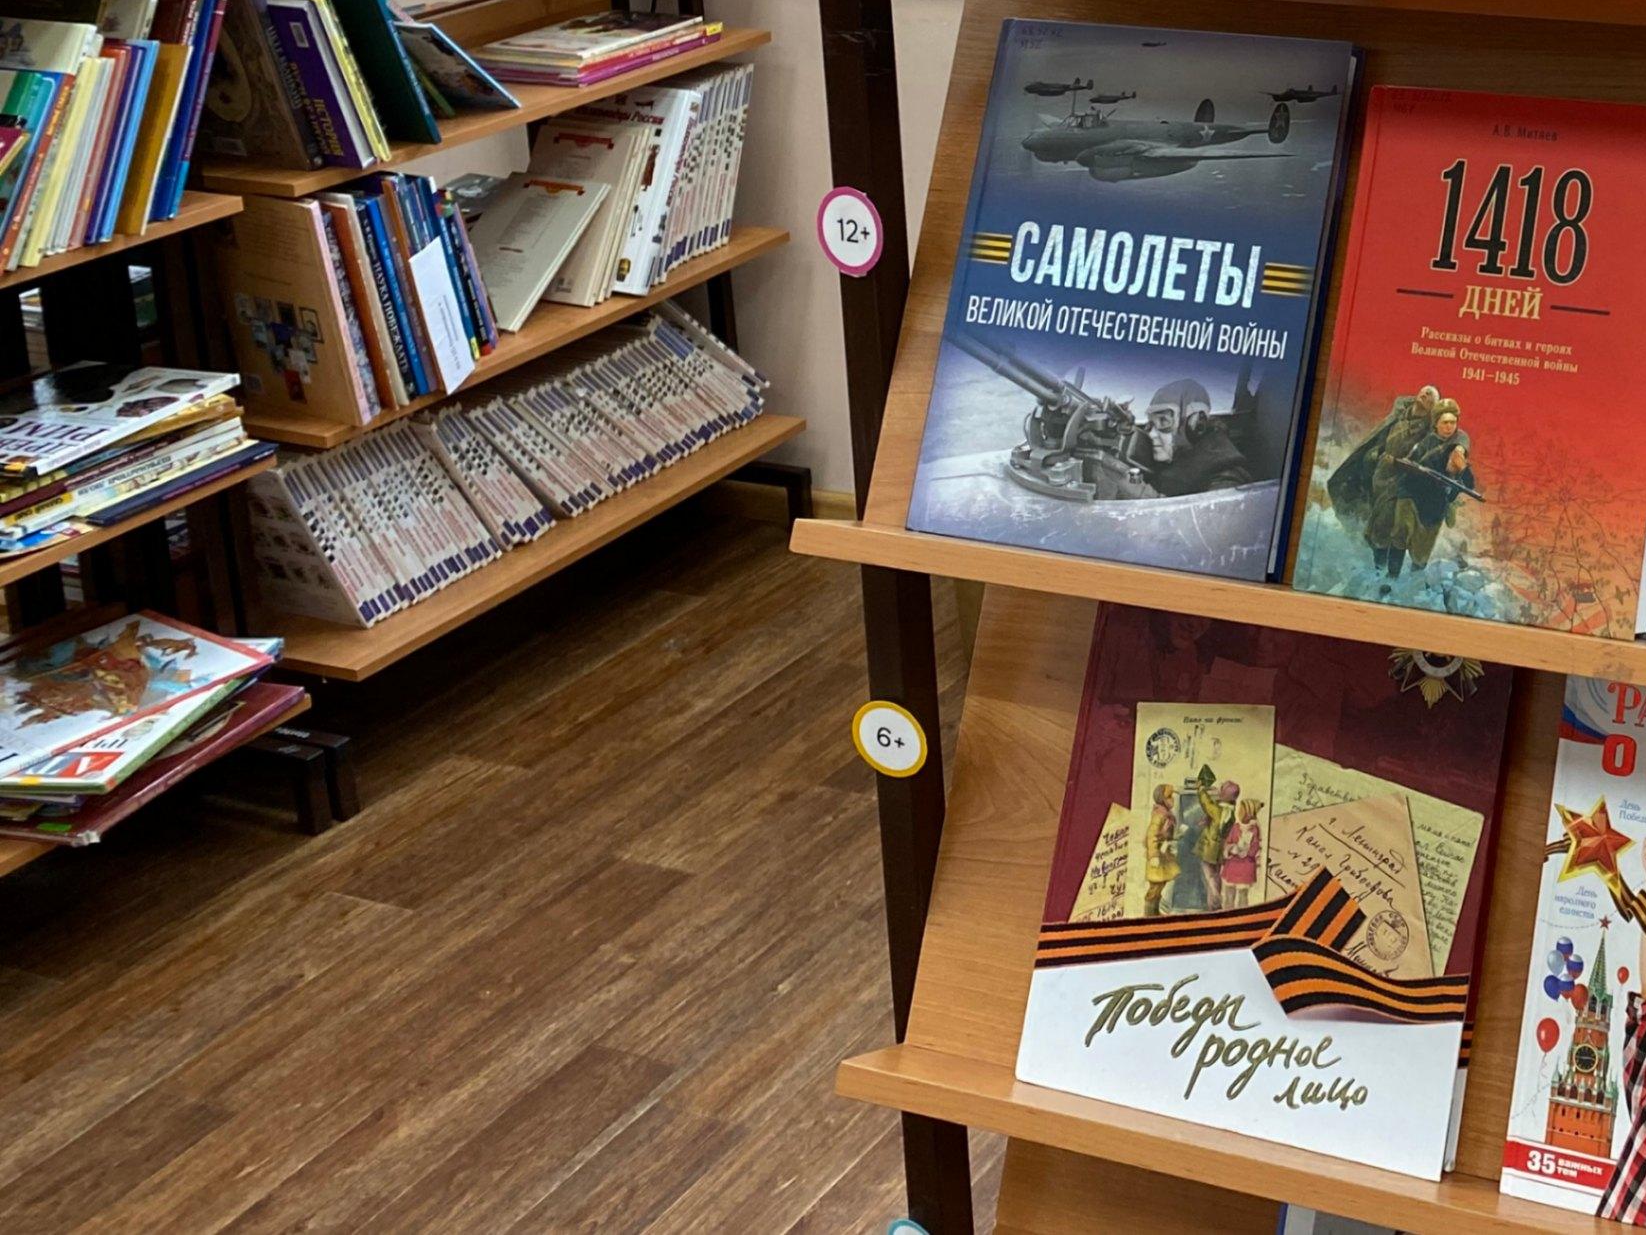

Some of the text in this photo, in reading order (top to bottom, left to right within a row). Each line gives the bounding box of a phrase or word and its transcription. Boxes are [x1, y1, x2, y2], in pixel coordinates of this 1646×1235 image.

[837, 218, 870, 243] 12+
[1429, 159, 1594, 287] 1418
[1009, 220, 1262, 309] САМОЛЕТЫ
[1458, 285, 1544, 320] ДНЕЙ
[965, 295, 1288, 360] ВЕЛИКОЙ ОТЕЧЕСТВЕННОЙ ВОЙНЫ
[1421, 326, 1572, 356] Рассказы о битвах и героях
[1411, 342, 1578, 373] Великой Отечественной войны
[876, 727, 905, 750] 6+
[1600, 734, 1637, 777] О
[1619, 799, 1641, 811] День
[1576, 886, 1598, 899] День
[1085, 974, 1261, 1059] Победы
[1184, 1031, 1343, 1101] родное
[1274, 1076, 1369, 1110] лицо
[1527, 1150, 1603, 1176] 35 важных
[1557, 1166, 1578, 1178] тем
